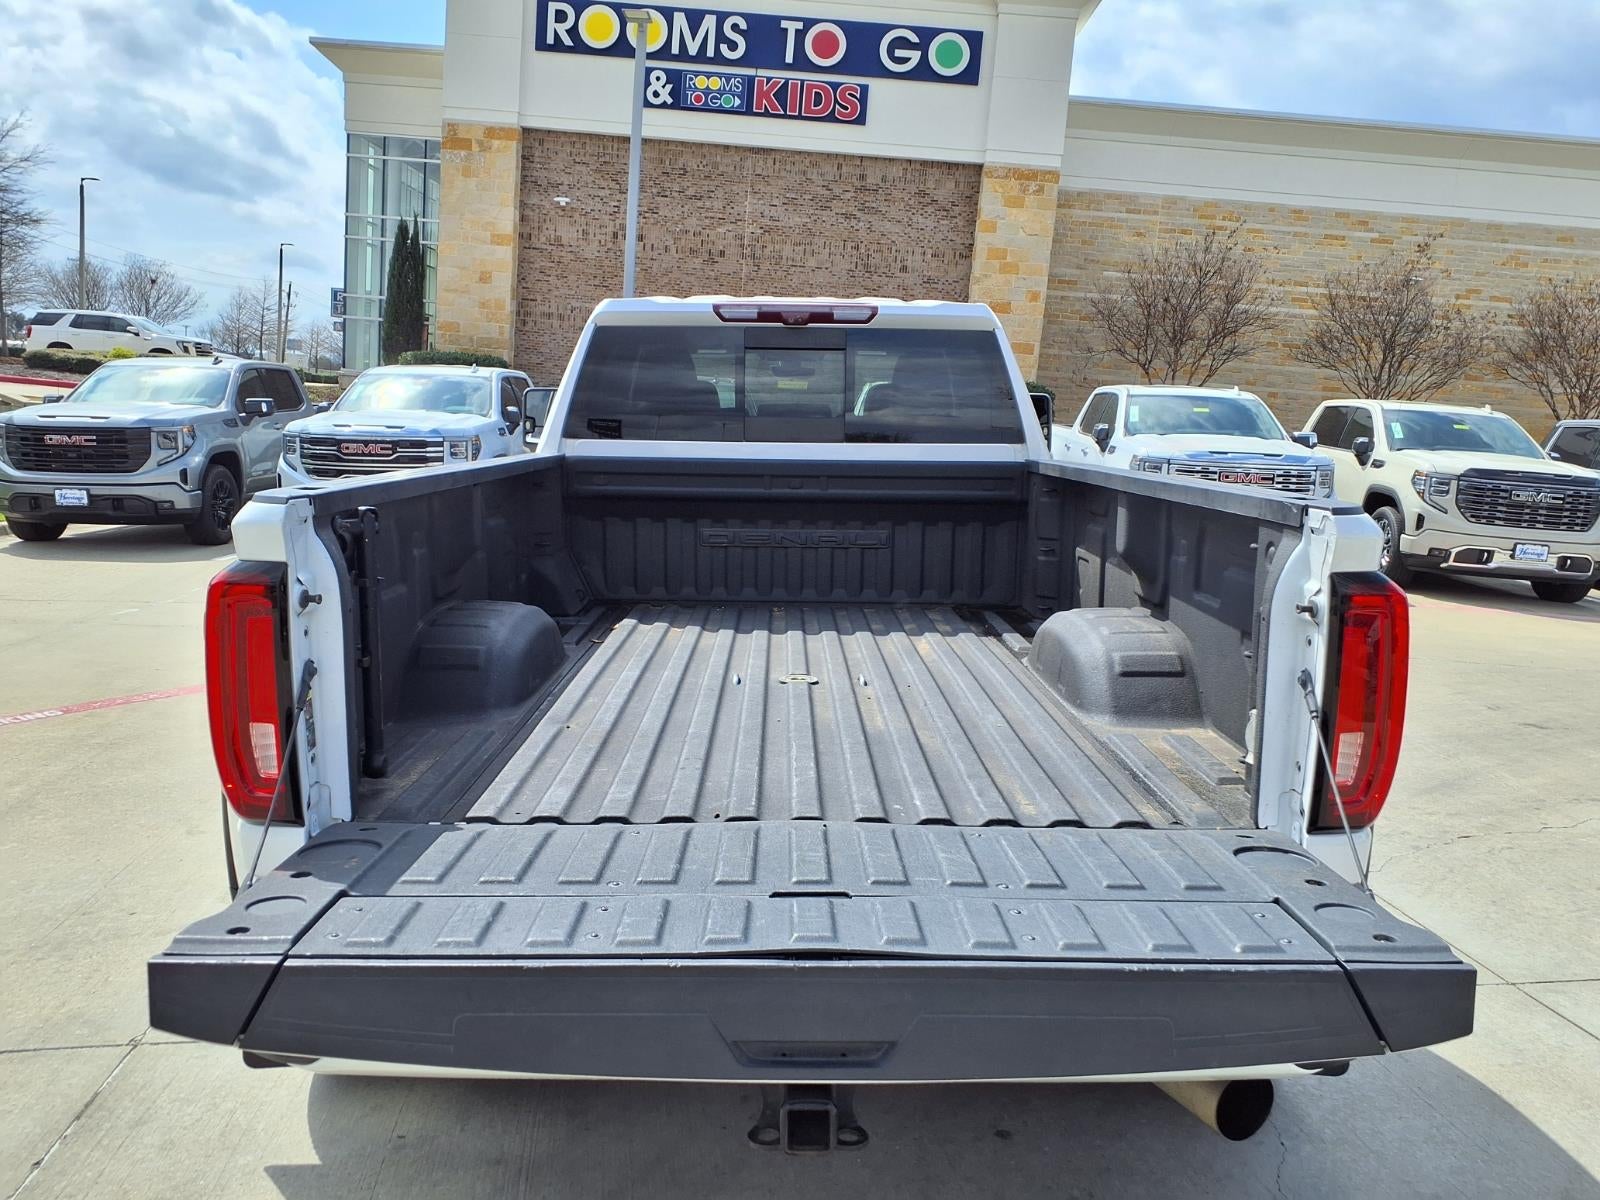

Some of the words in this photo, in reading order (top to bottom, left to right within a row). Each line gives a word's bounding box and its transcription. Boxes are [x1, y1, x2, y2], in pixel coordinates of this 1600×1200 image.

[546, 1, 748, 60] ROOMS
[780, 20, 847, 67] TO
[879, 28, 971, 77] GO
[646, 69, 674, 105] &
[686, 74, 742, 92] ROOMS
[686, 91, 705, 106] TO
[708, 93, 734, 108] GO
[753, 78, 862, 121] KIDS
[44, 434, 97, 446] GMC
[340, 442, 393, 455] GMC
[1220, 472, 1273, 484] GMC
[1511, 490, 1565, 504] GMC
[702, 529, 890, 548] DENALI
